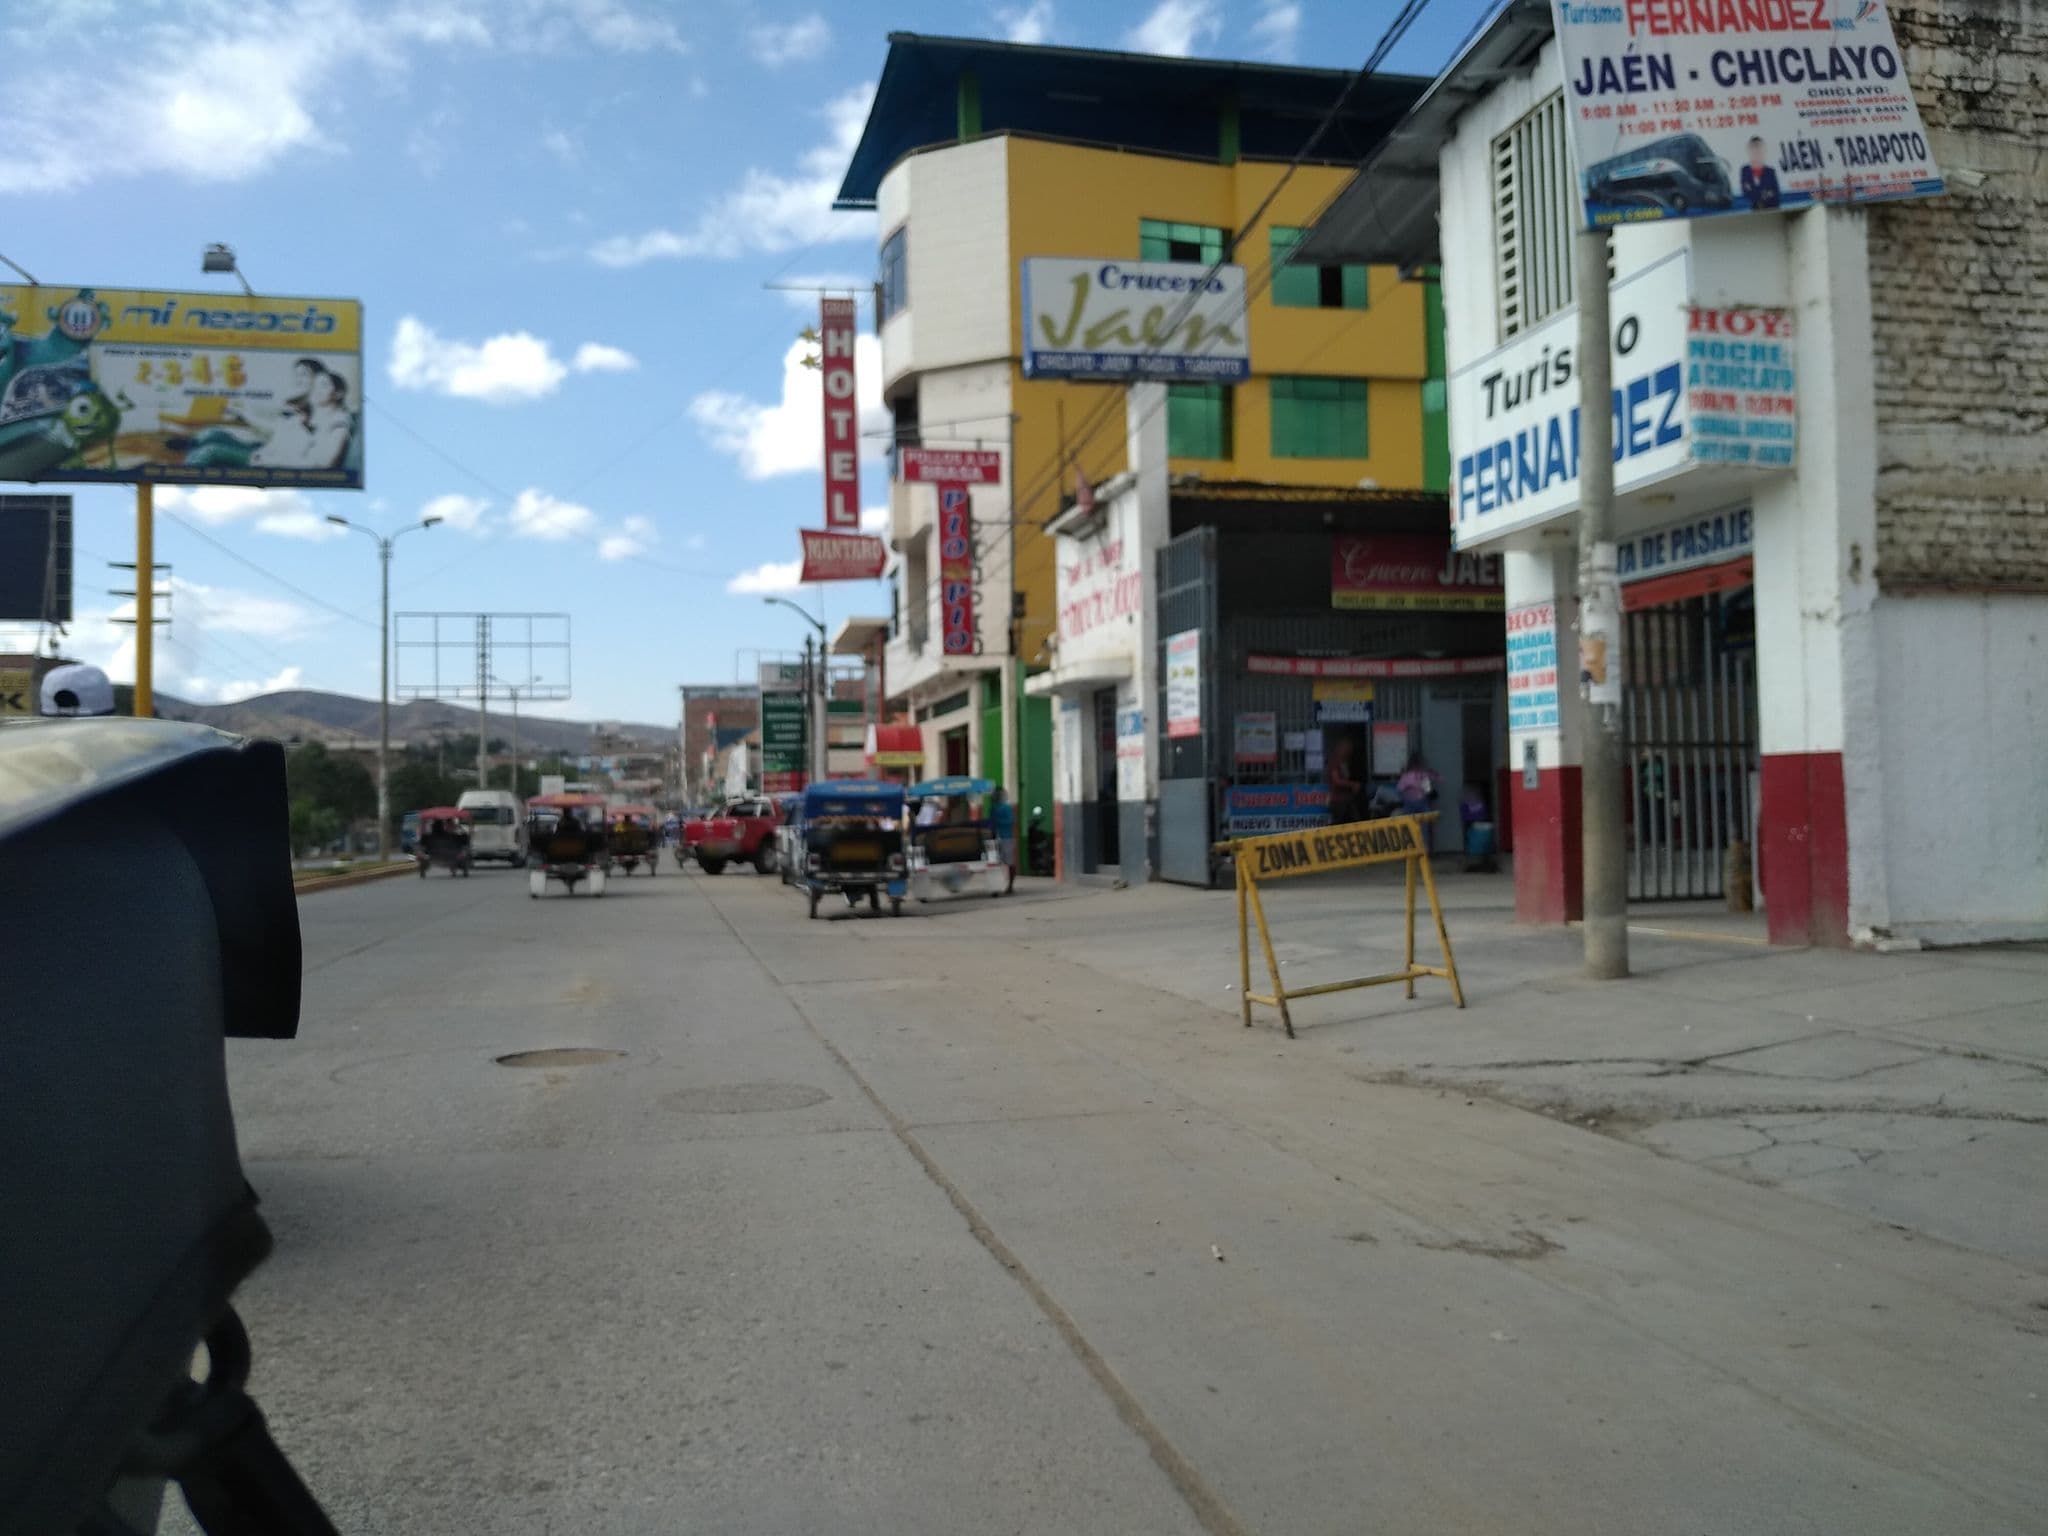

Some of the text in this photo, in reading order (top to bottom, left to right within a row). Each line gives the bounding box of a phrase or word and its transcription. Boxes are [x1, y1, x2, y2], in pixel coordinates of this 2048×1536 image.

[1574, 42, 1676, 96] JAÉN
[1711, 44, 1898, 87] CHICLAYO
[1660, 119, 1682, 132] PM
[1737, 113, 1759, 126] PM
[1761, 93, 1781, 107] PM
[1779, 129, 1824, 173] JAÉN
[1834, 131, 1926, 167] TARAPOTO
[1099, 264, 1224, 293] Crucero
[1481, 316, 1639, 419] Turiso
[827, 329, 857, 523] HOTEL
[1458, 363, 1683, 521] FERNADEZ
[1671, 509, 1752, 556] PASAJE
[1257, 823, 1416, 872] ZONA RESERVADA
